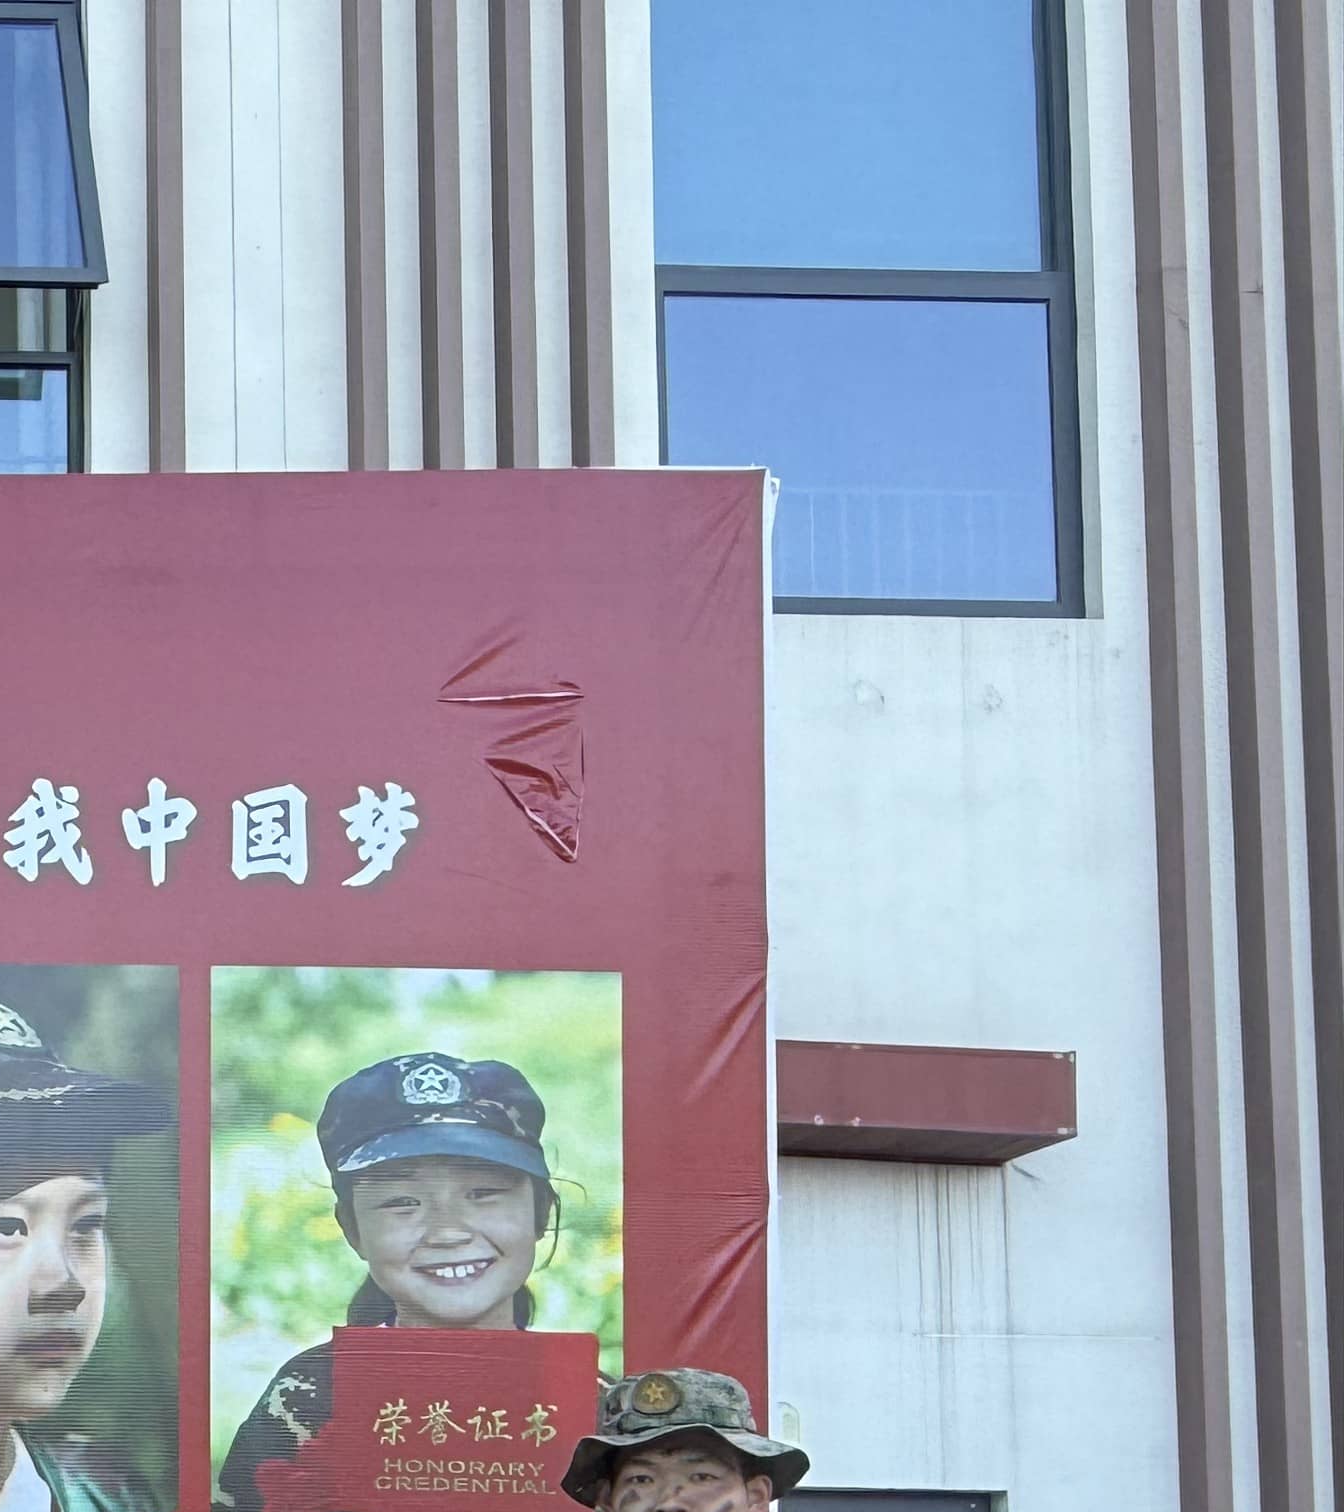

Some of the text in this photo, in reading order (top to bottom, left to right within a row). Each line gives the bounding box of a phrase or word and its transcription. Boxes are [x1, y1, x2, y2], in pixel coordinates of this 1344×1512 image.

[372, 1397, 560, 1448] 荣誉证书
[383, 1458, 546, 1477] HONORARY
[374, 1475, 557, 1495] CREDENTIAL
